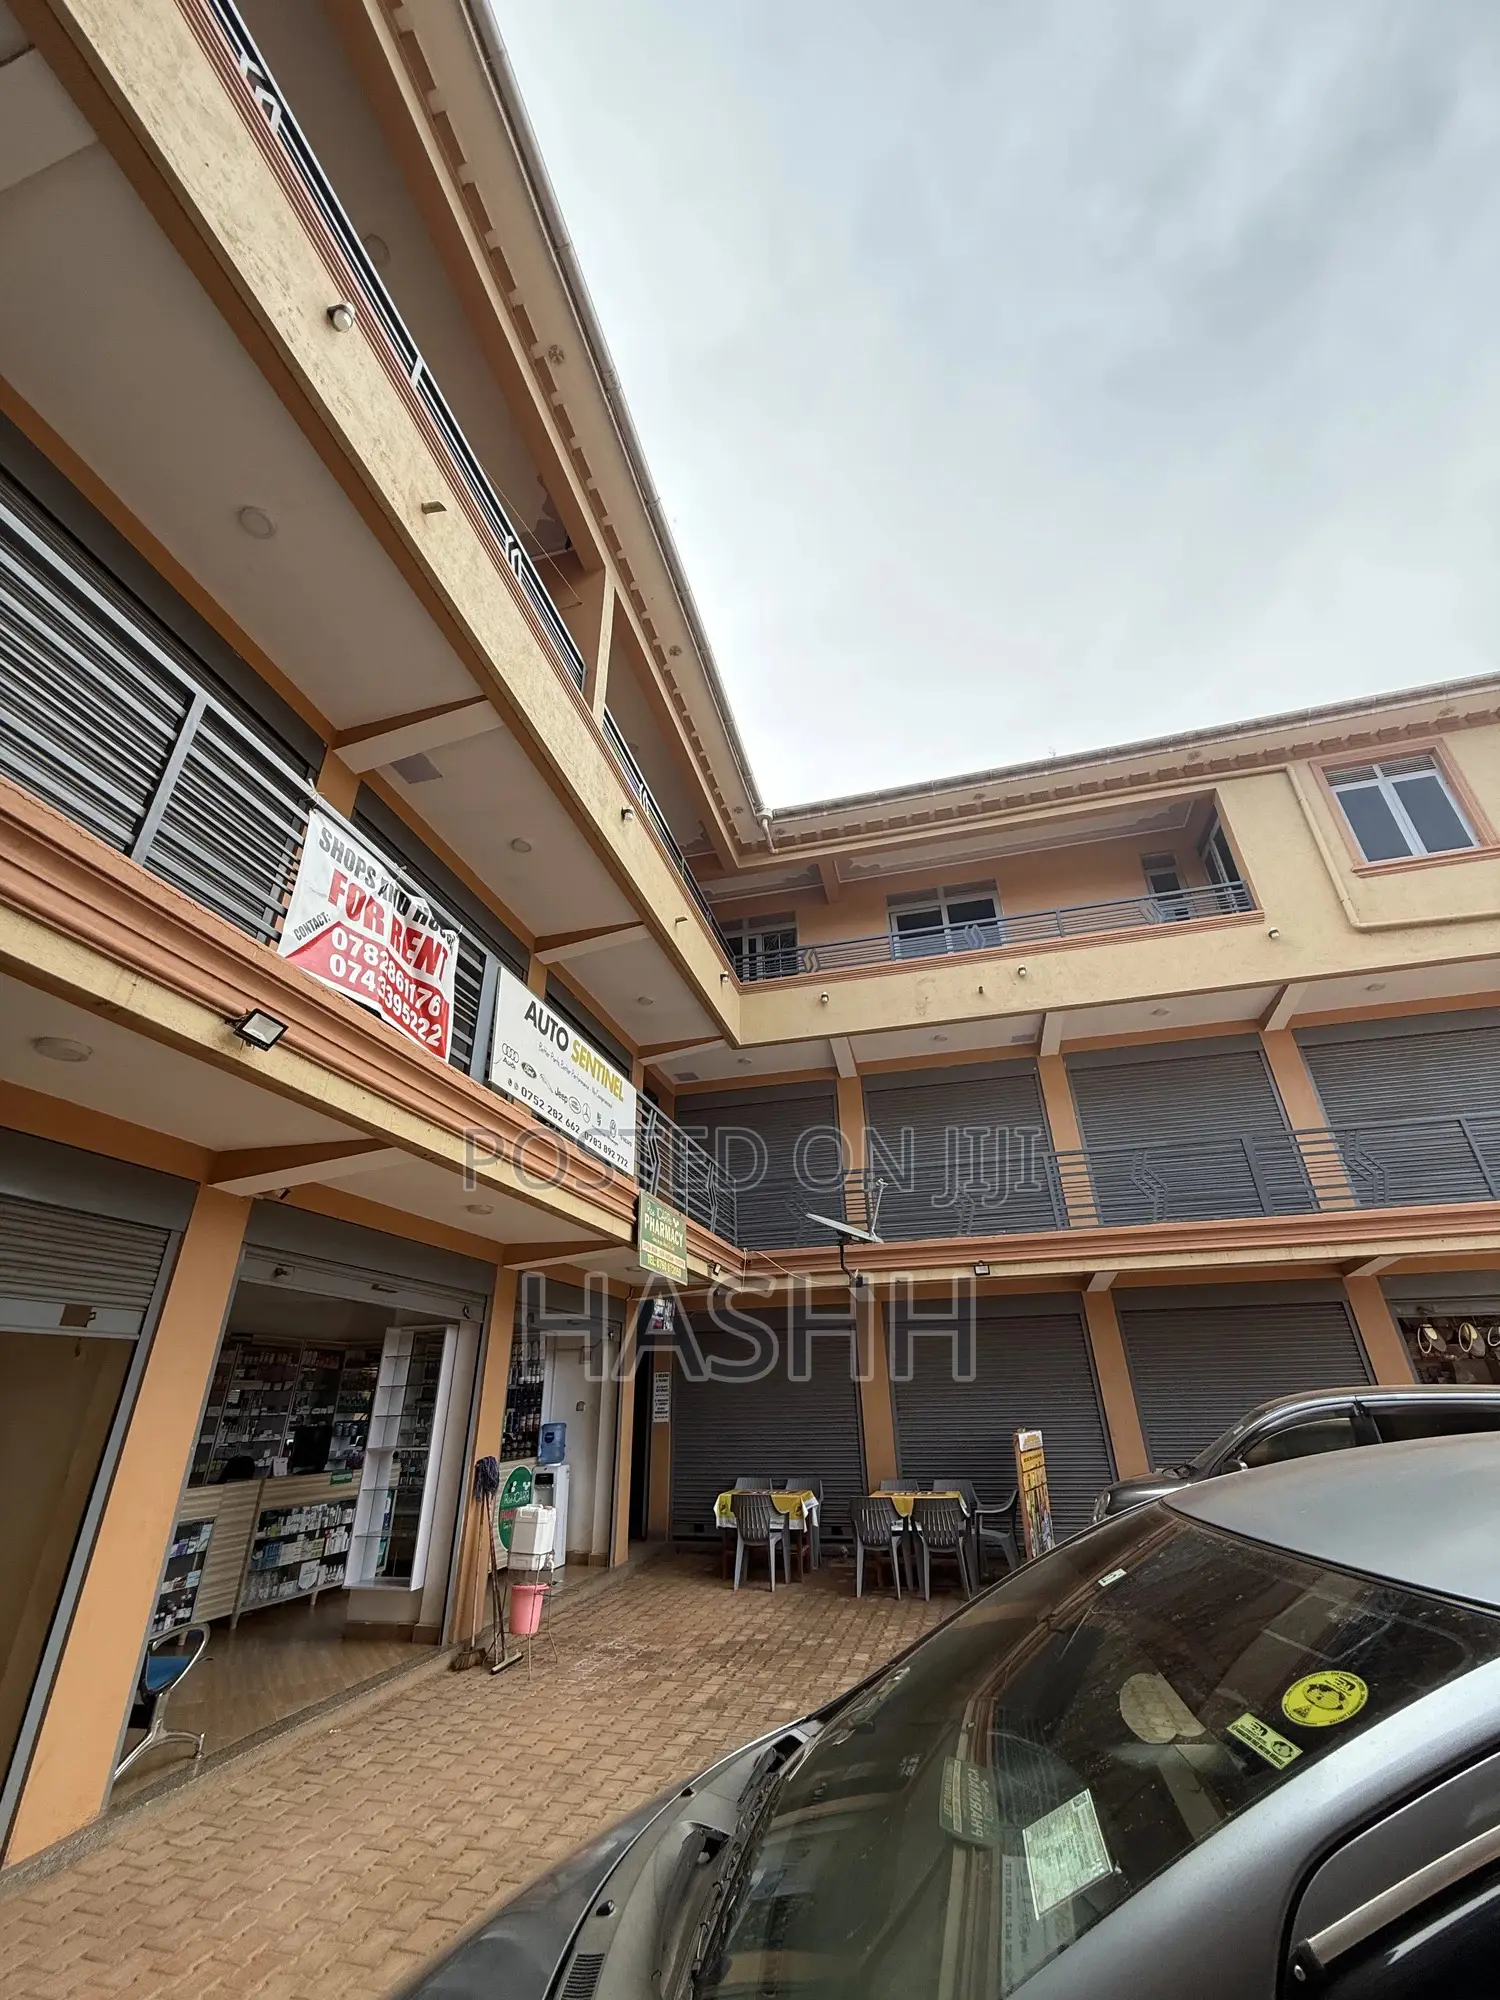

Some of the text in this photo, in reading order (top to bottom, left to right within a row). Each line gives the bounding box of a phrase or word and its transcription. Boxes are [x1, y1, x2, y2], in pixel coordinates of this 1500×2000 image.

[319, 827, 376, 889] SHOPS
[294, 912, 331, 941] CONTACT:
[328, 869, 449, 982] FOR RENT
[329, 953, 443, 1047] 0743395222
[331, 927, 441, 1016] 0782861176
[524, 1000, 624, 1102] AUTO SENTINEL
[521, 1086, 545, 1110] 0752
[547, 1105, 564, 1123] 282
[565, 1118, 580, 1134] 662
[584, 1131, 602, 1149] 0783
[604, 1145, 615, 1159] 892
[617, 1153, 629, 1168] 772
[555, 1087, 568, 1104] Jeep
[644, 1213, 683, 1248] PHARMACY
